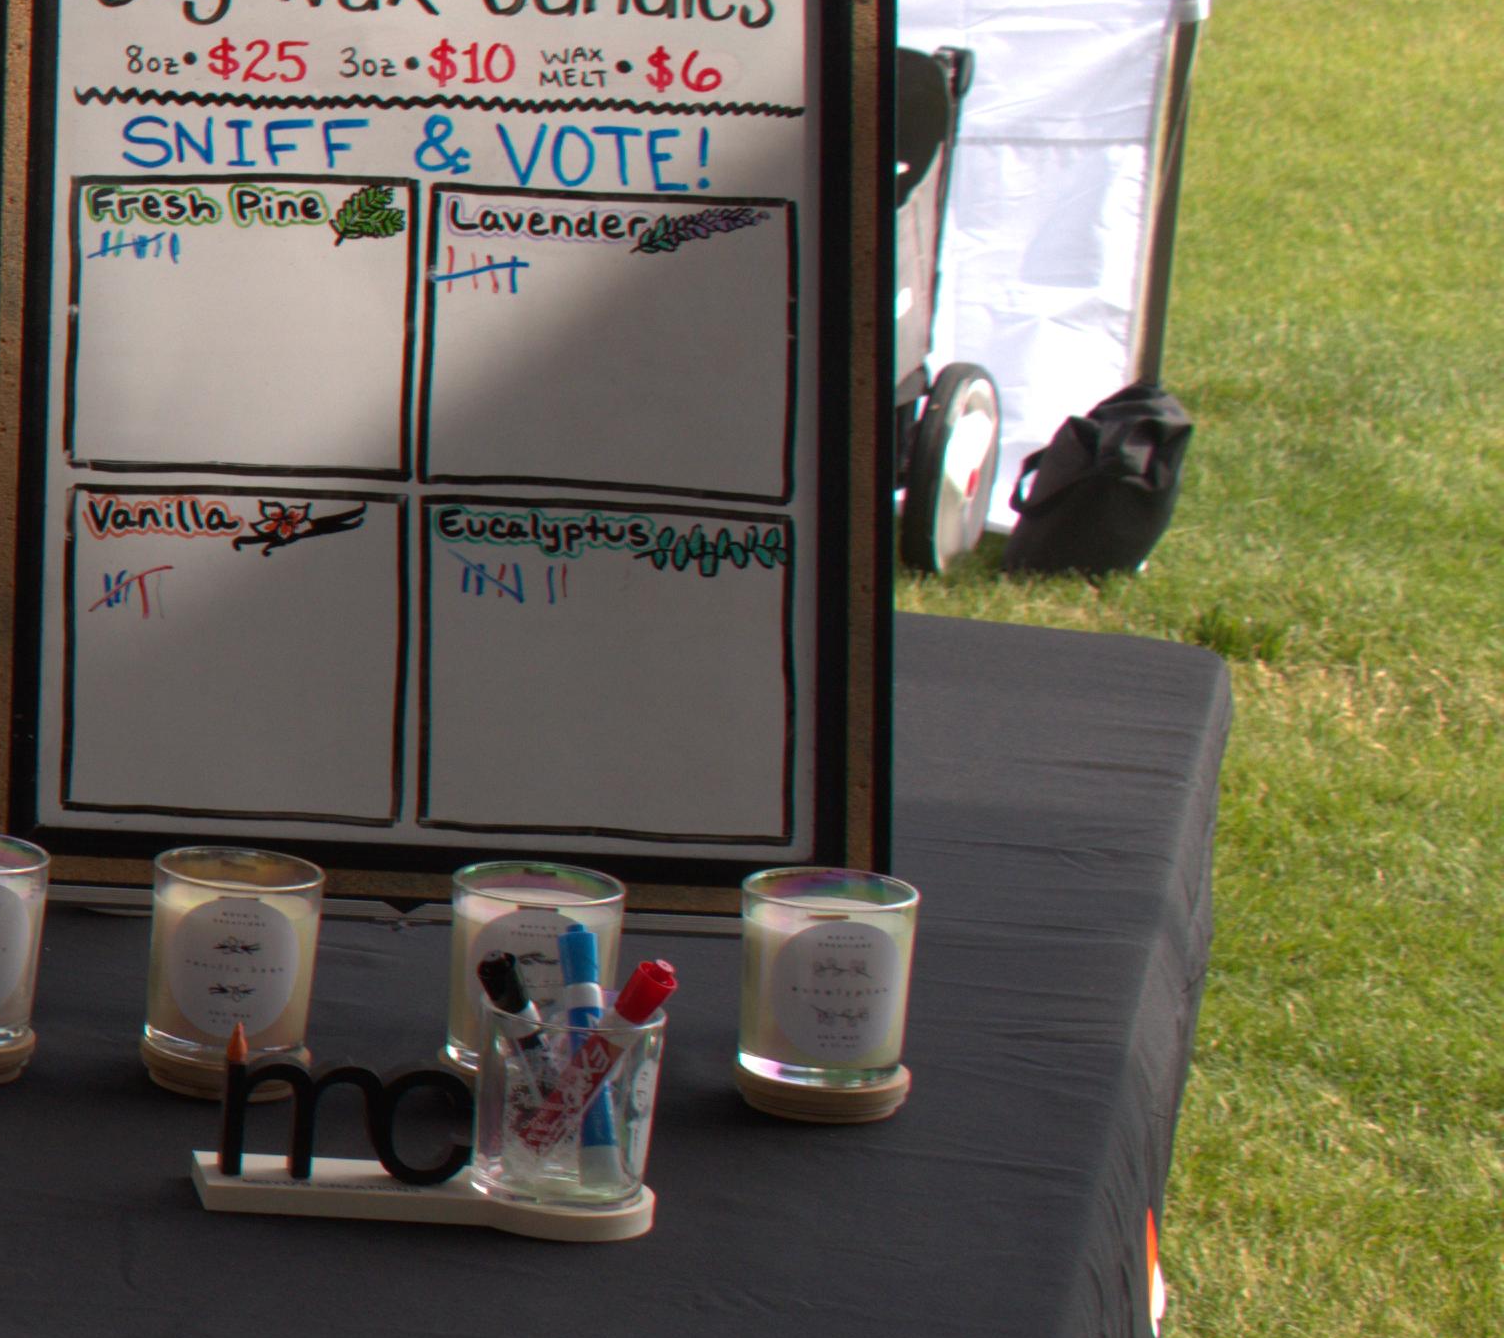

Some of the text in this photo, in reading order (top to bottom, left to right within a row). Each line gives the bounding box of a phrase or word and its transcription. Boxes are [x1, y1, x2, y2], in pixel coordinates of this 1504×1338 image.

[207, 37, 310, 86] $25
[428, 39, 517, 87] $10
[541, 47, 605, 67] WAX
[646, 46, 723, 93] $6
[538, 68, 610, 91] MELT
[121, 114, 713, 193] SNIFF & VOTE!
[88, 186, 323, 224] Fresh Pine
[449, 197, 649, 240] Lavender
[88, 495, 239, 536] Vanilla
[436, 507, 651, 556] Eucalyptus
